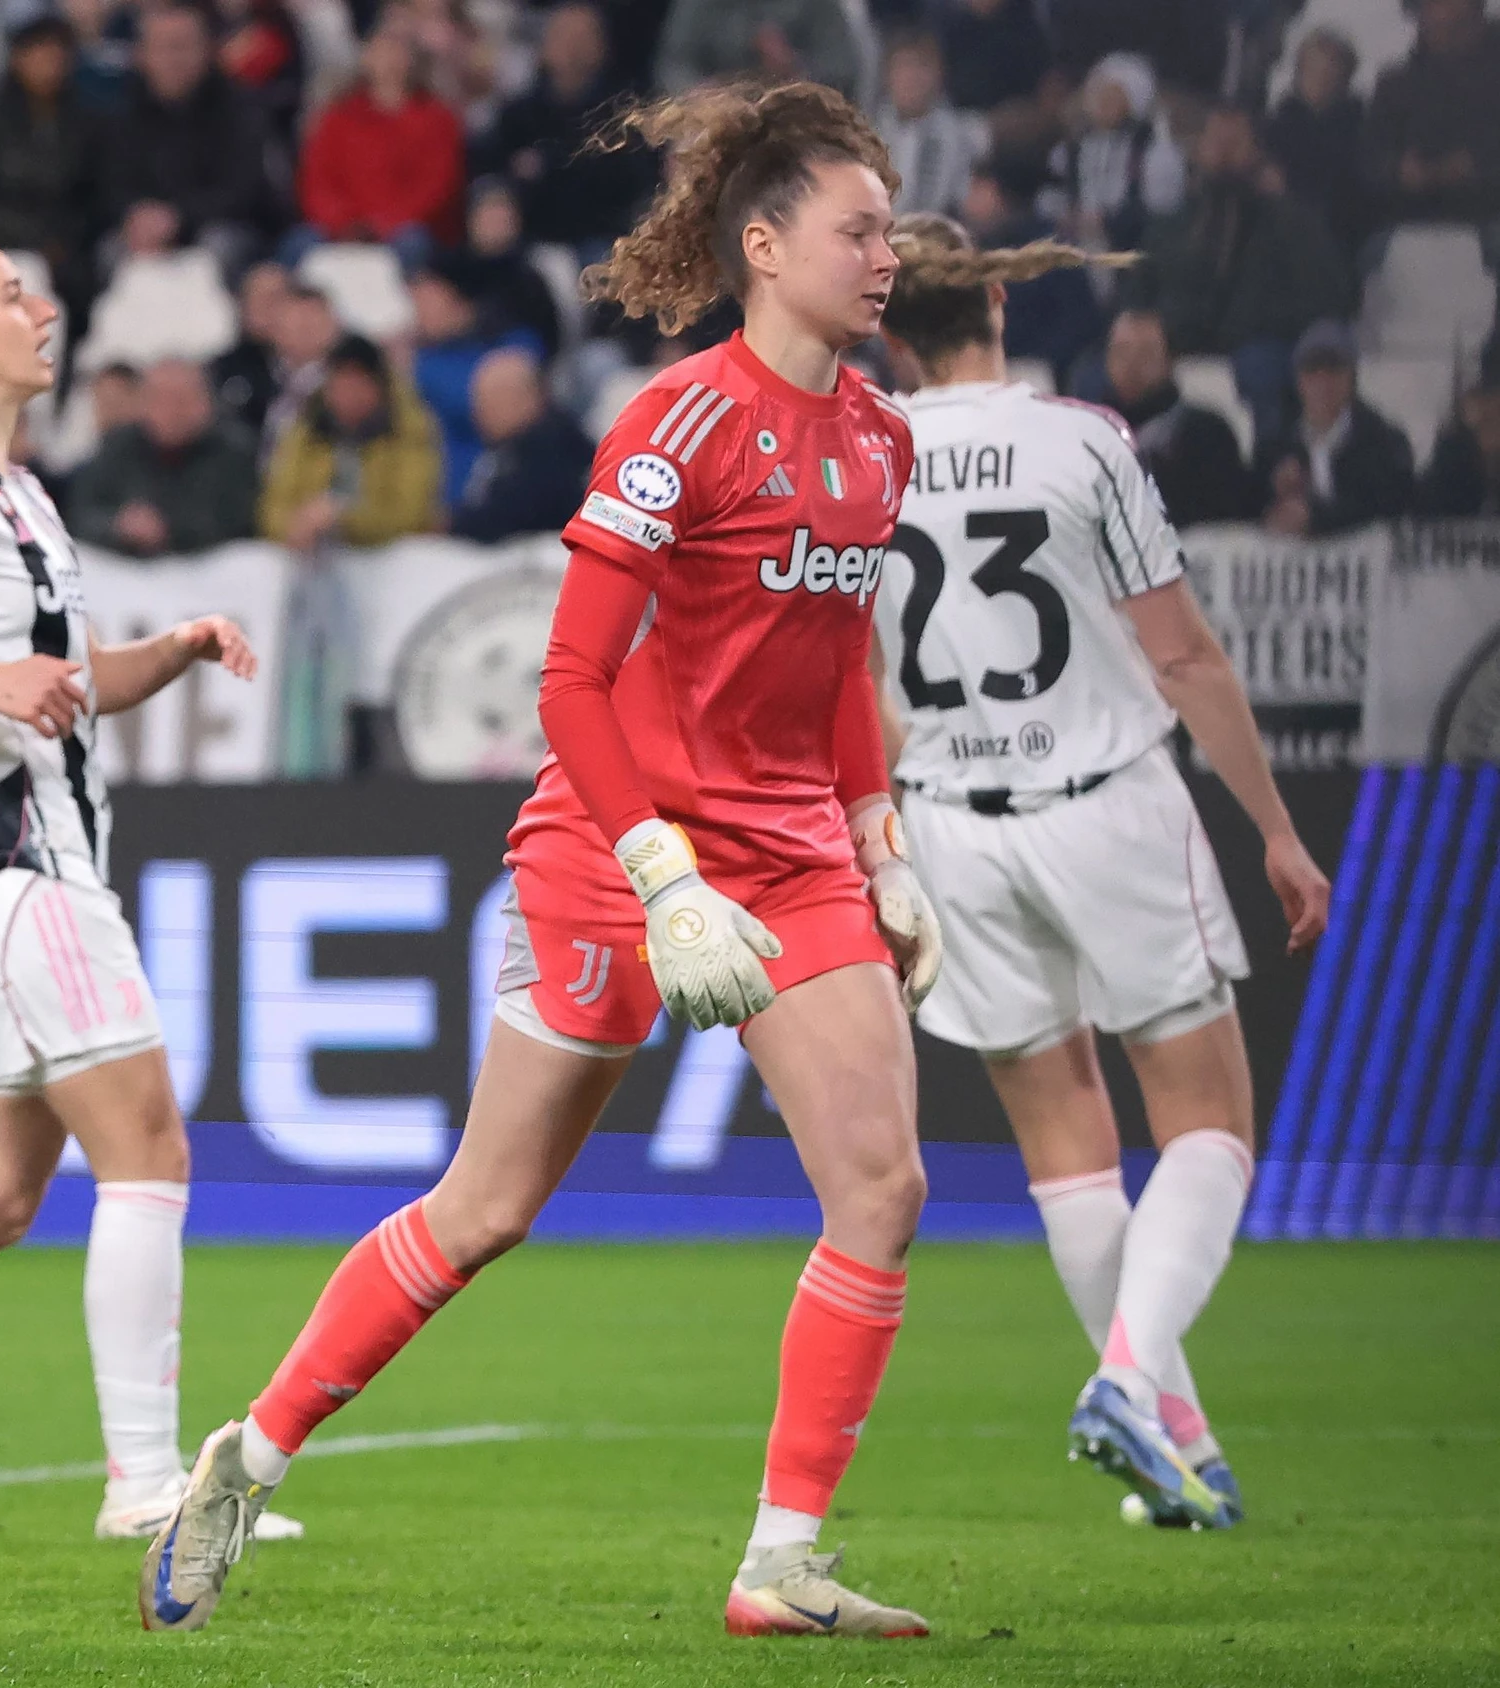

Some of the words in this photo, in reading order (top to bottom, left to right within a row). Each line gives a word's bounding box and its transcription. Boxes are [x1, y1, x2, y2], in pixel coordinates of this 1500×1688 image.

[911, 444, 1015, 493] ALVAI
[759, 526, 886, 607] Jeep
[885, 508, 1071, 709] 23
